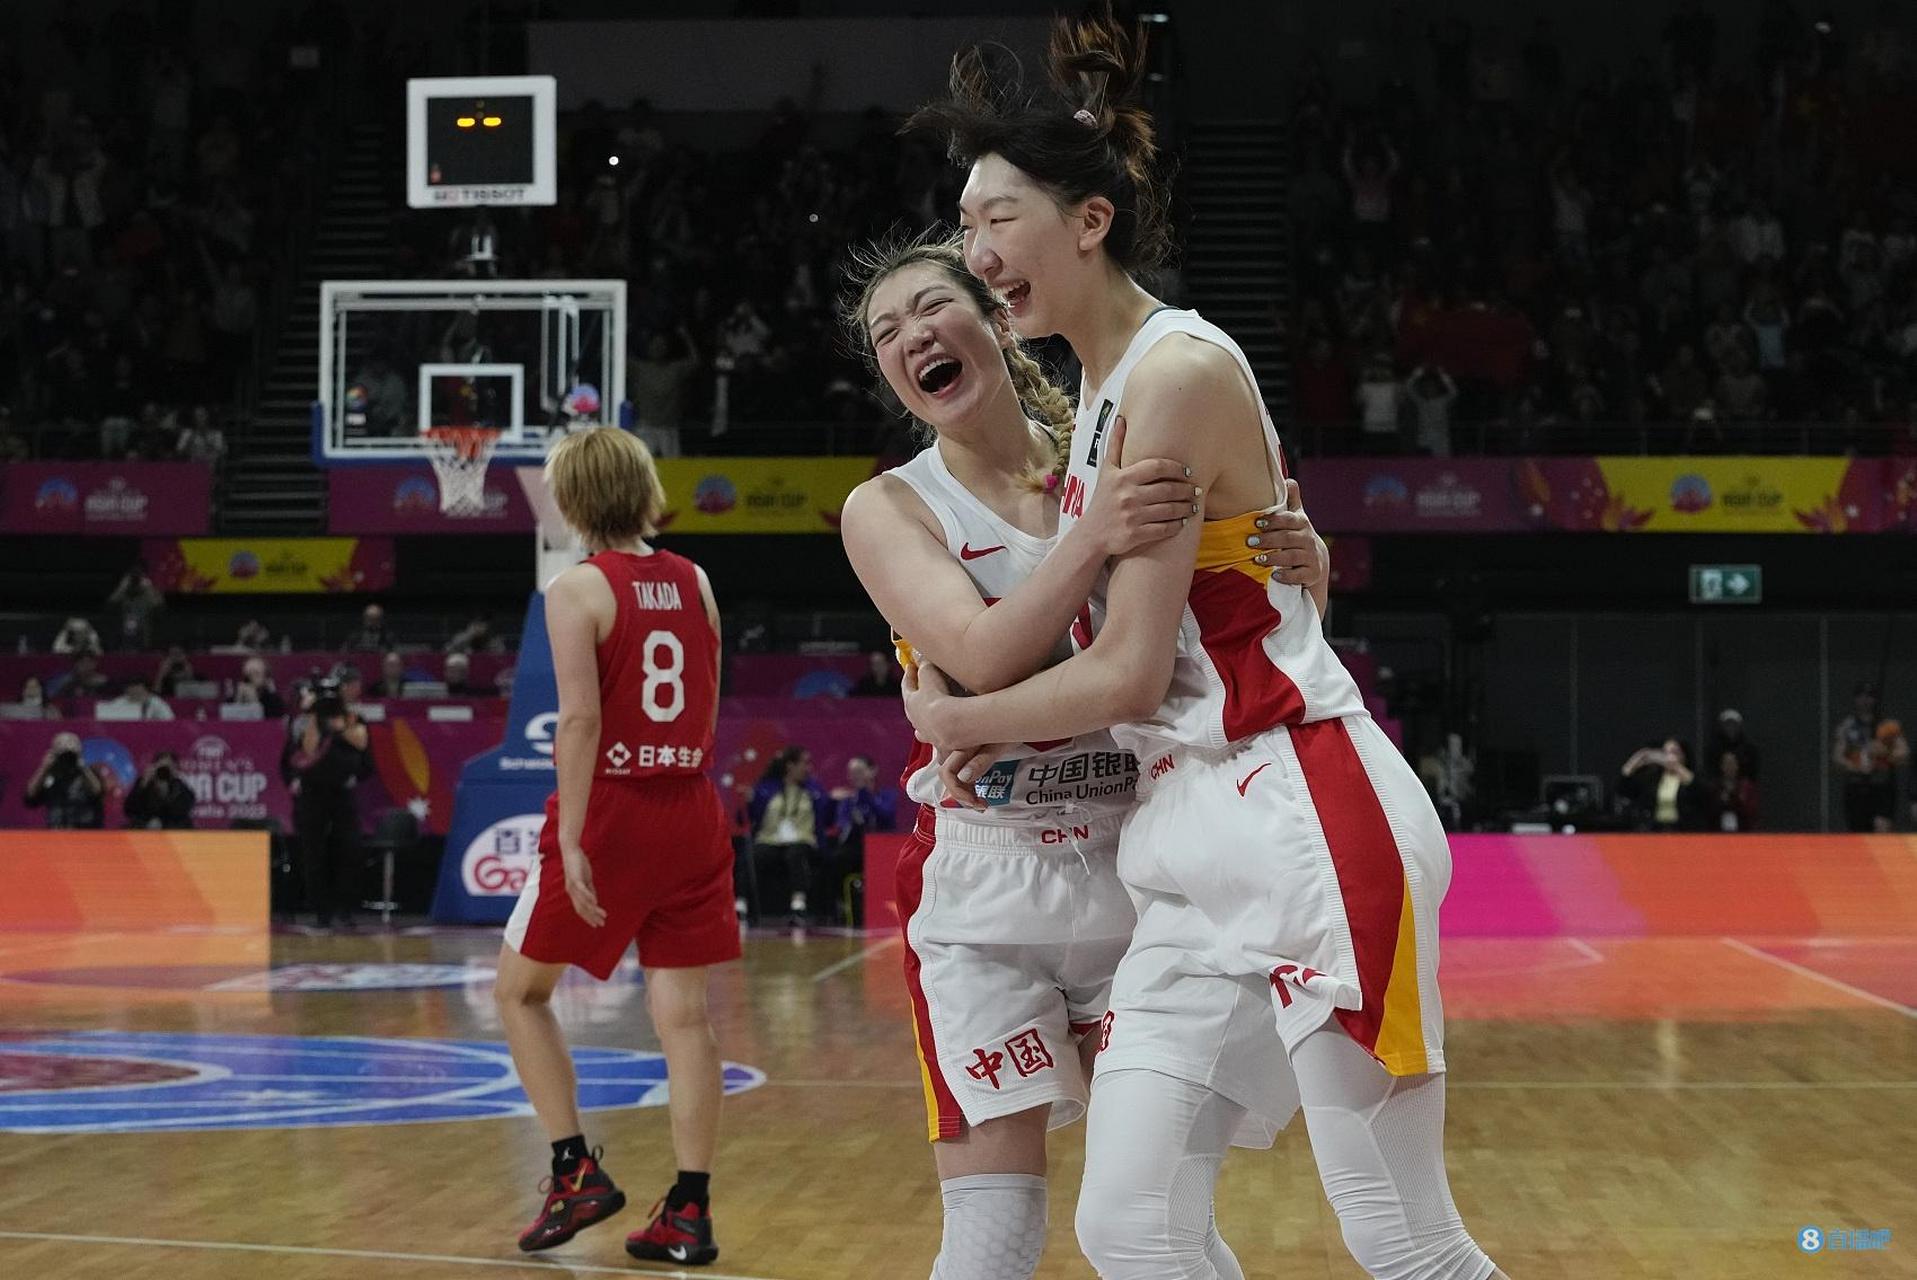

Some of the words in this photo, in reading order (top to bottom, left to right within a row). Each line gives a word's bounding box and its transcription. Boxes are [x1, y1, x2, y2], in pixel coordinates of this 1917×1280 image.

[462, 188, 524, 200] TISSOT
[632, 581, 682, 611] TAKADA
[642, 630, 685, 722] 8
[1151, 754, 1175, 780] CHN
[216, 770, 269, 803] CUP
[1026, 789, 1072, 805] China
[965, 1028, 1054, 1090] 中国
